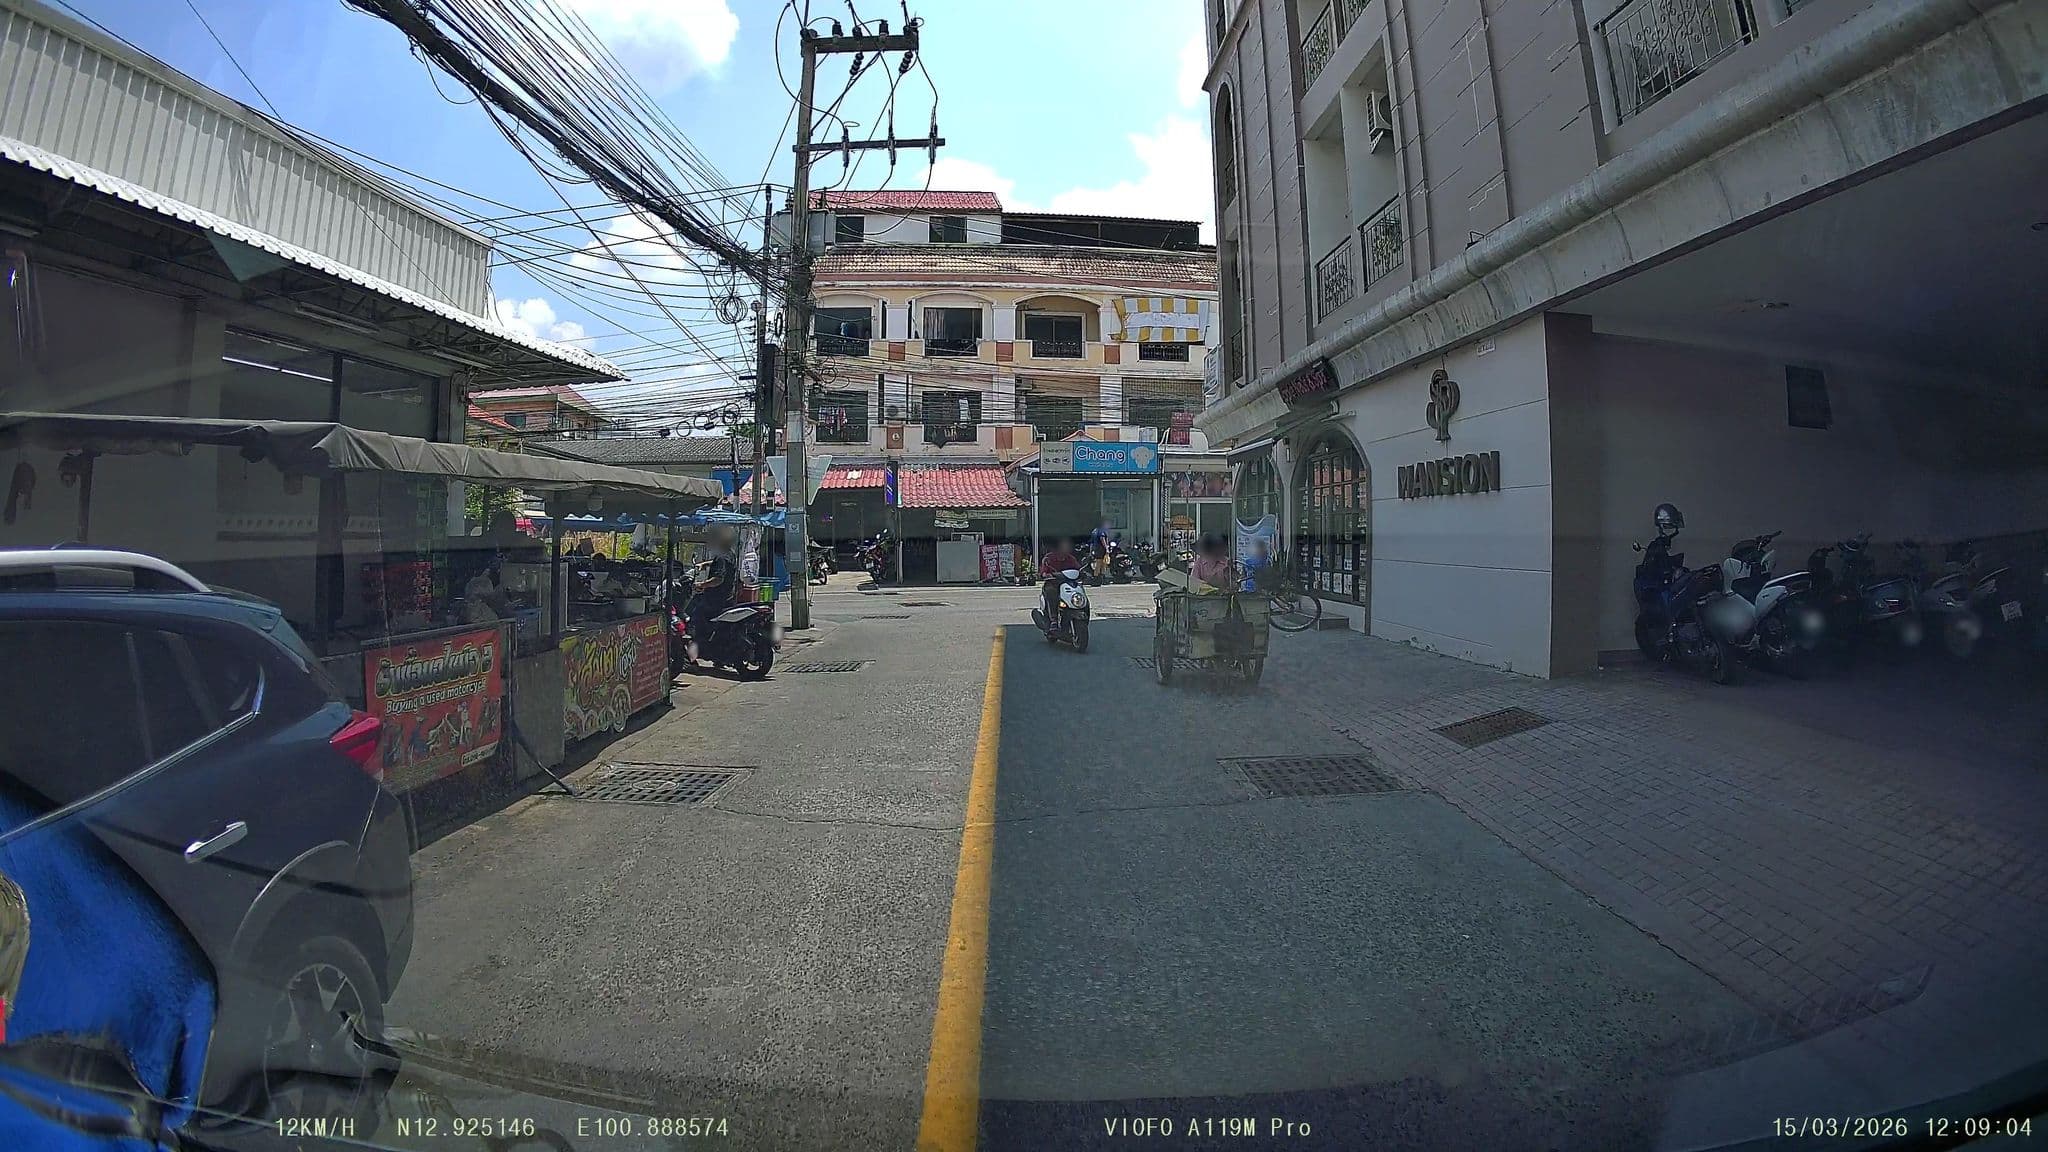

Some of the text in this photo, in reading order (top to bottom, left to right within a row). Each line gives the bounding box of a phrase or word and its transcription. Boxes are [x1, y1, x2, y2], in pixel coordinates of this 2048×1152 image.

[1075, 446, 1126, 464] Chang
[1397, 450, 1501, 500] MANSION
[386, 696, 418, 714] Buying
[420, 696, 426, 706] a
[427, 689, 446, 704] used
